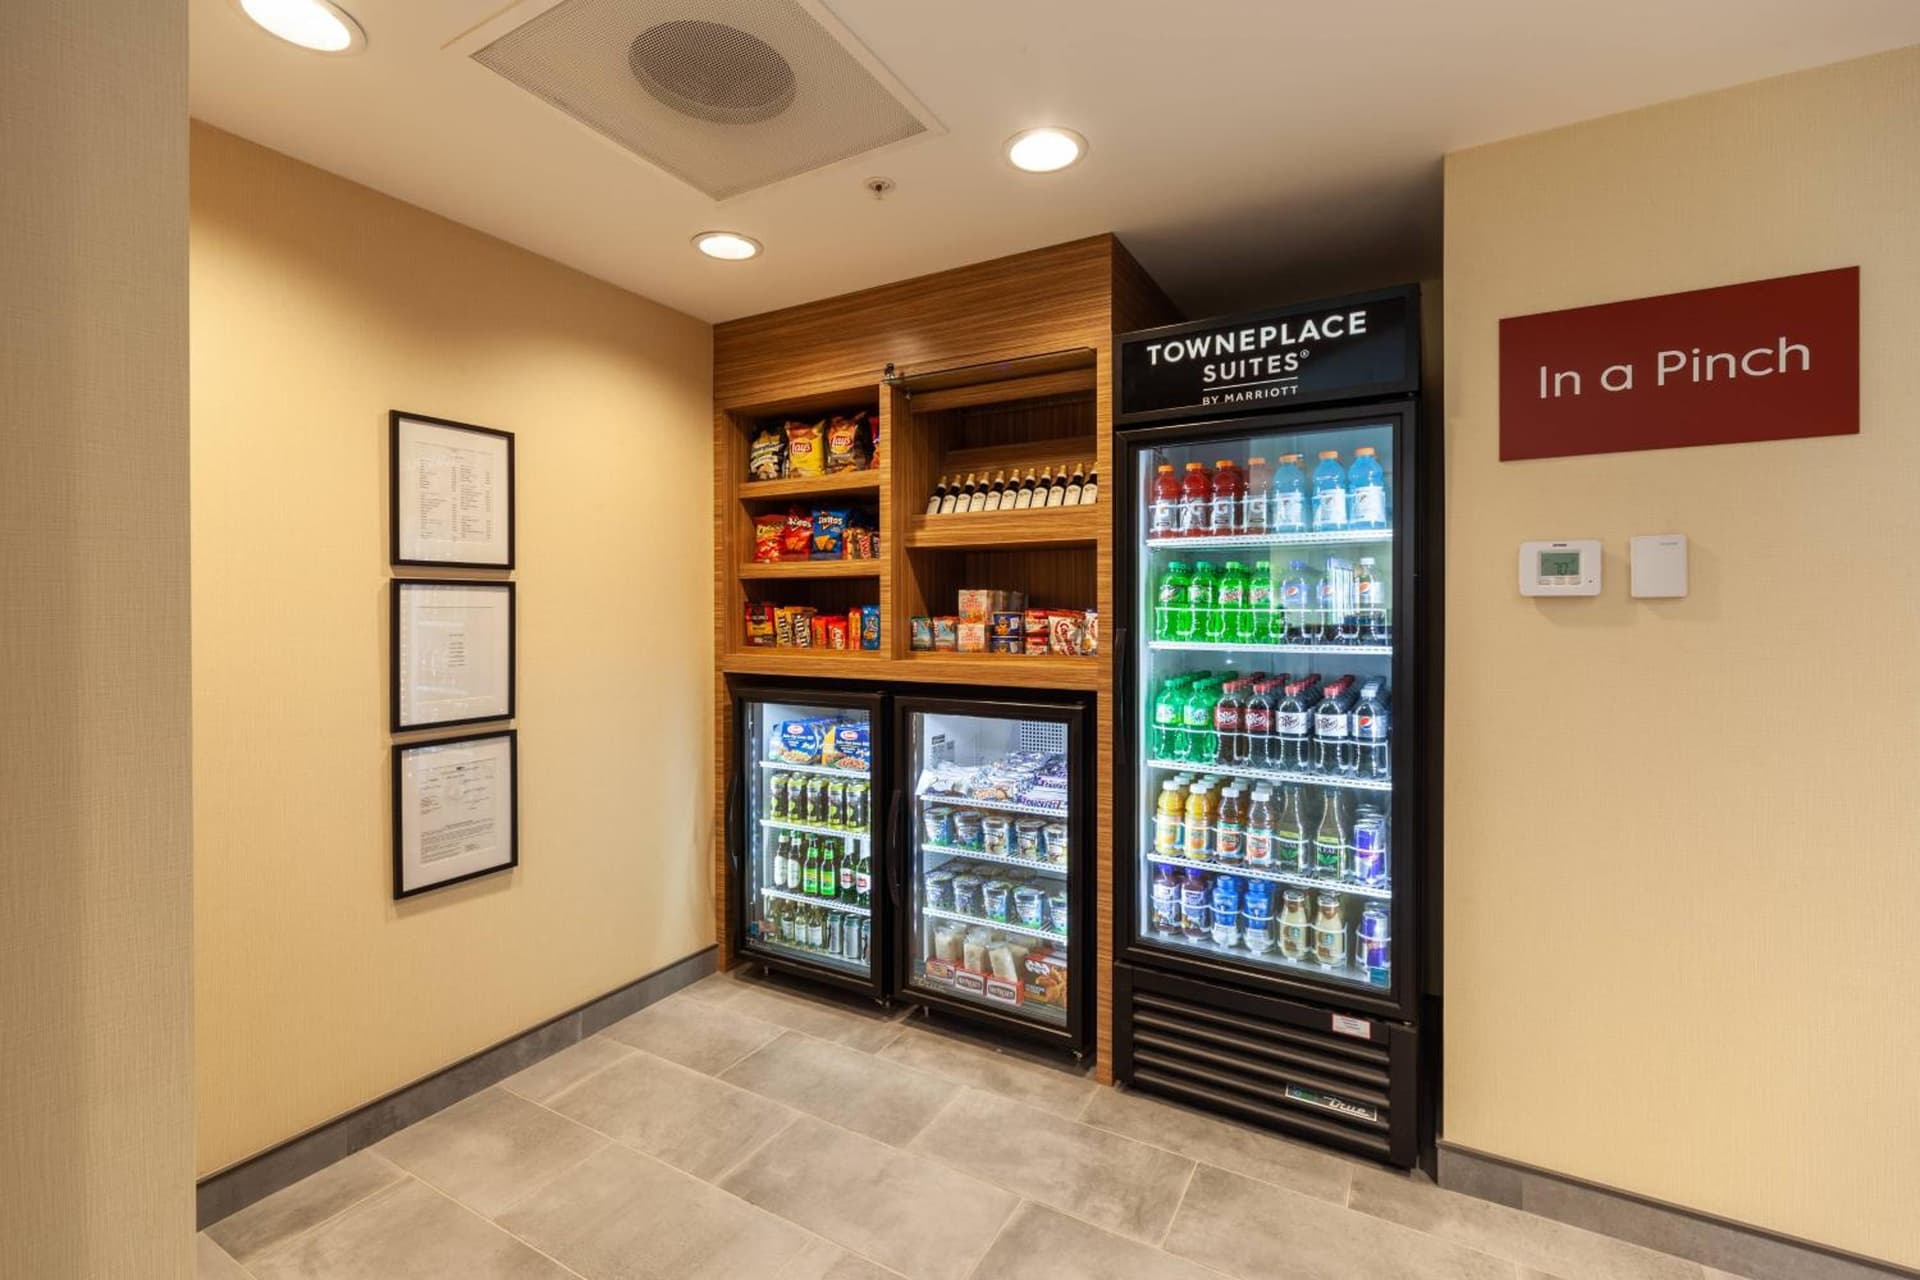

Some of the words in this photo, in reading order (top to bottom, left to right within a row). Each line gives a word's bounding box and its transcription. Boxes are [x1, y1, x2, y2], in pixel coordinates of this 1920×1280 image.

[1146, 310, 1368, 366] TOWNEPLACE
[1202, 395, 1219, 406] BY
[1224, 385, 1299, 403] MARRIOTT
[1539, 365, 1581, 400] In
[1600, 363, 1633, 392] a
[1657, 336, 1811, 387] Pinch
